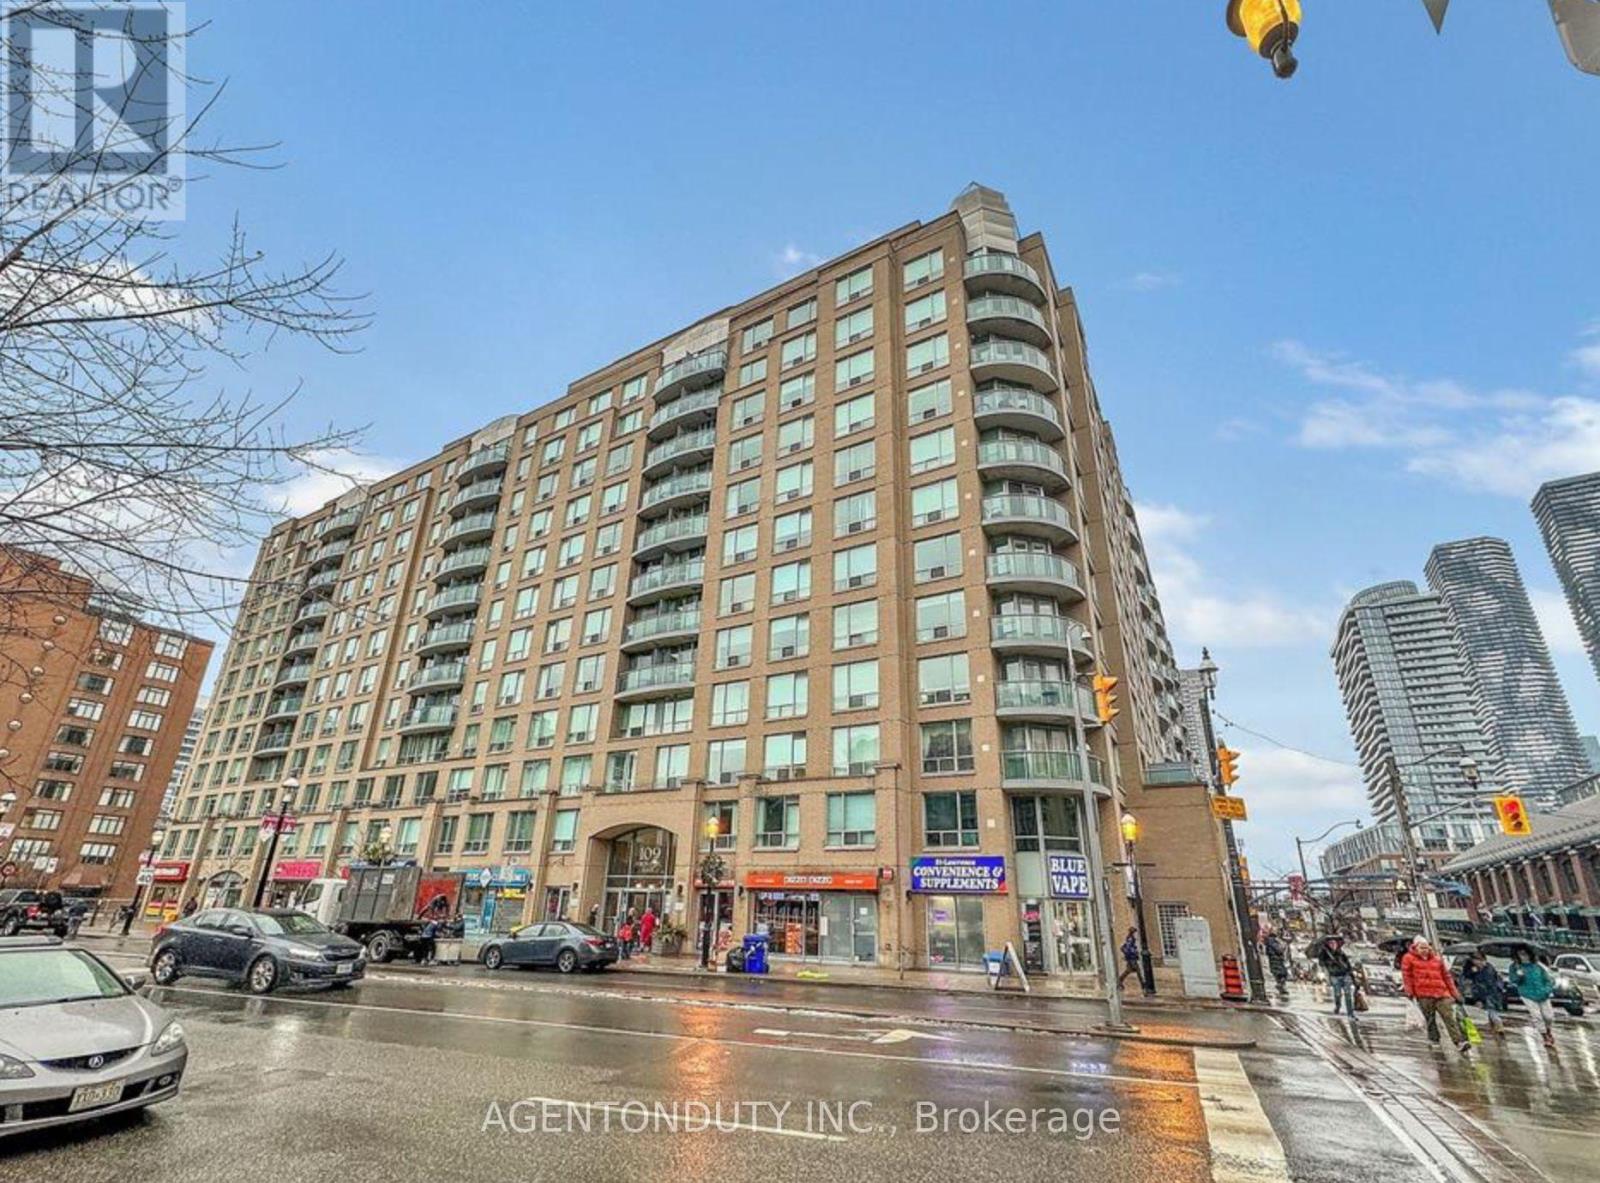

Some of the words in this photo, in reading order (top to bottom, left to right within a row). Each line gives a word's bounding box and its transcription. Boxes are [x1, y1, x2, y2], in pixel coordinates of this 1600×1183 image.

[640, 847, 661, 860] 109
[913, 866, 990, 878] CONVENIENCE
[992, 866, 1003, 877] &
[1050, 858, 1086, 873] BLUE
[920, 877, 999, 890] SUPPLEMENTS
[1052, 874, 1089, 893] VAPE
